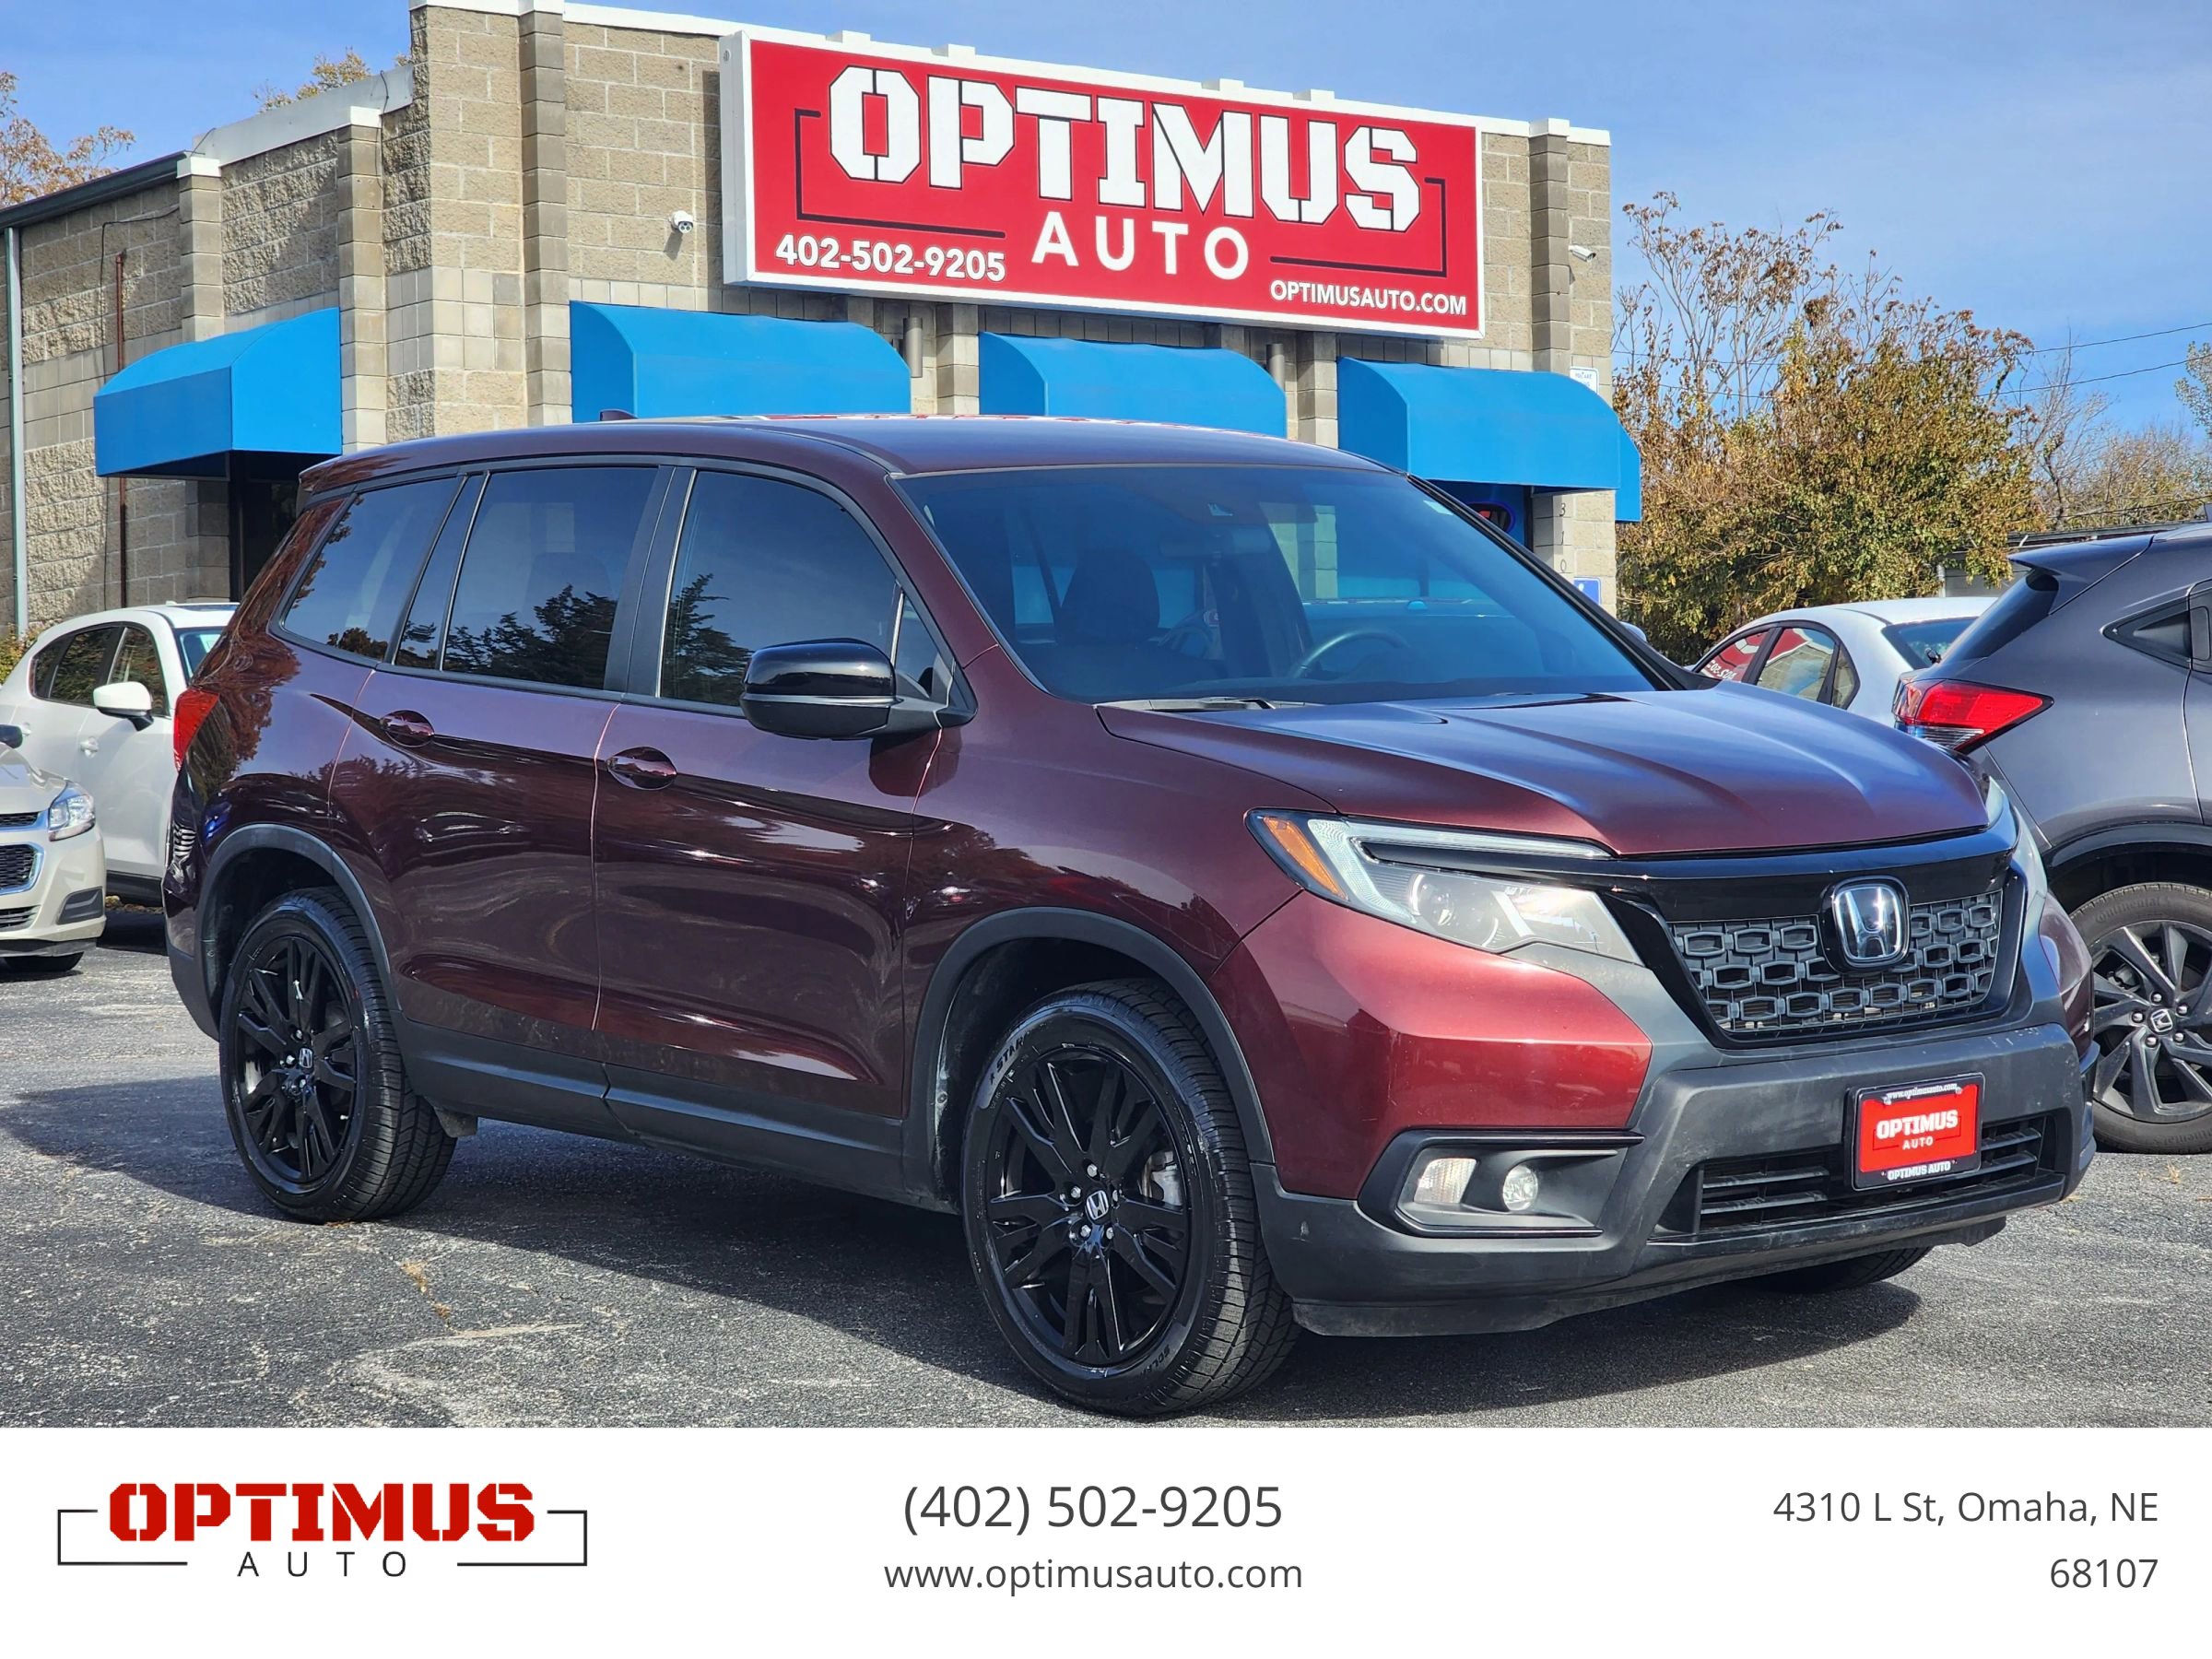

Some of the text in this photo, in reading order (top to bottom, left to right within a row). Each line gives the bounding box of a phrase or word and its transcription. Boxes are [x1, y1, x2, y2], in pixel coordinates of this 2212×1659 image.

[829, 64, 1421, 233] OPTIMUS
[775, 234, 1006, 283] 402-502-9205
[1031, 211, 1249, 280] AUTO
[1270, 280, 1467, 316] OPTIMUSAUTO.COM
[1876, 1109, 1959, 1139] OPTIMUS
[1902, 1135, 1934, 1150] AUTO
[1887, 1160, 1951, 1181] OPTIMUS AUTO
